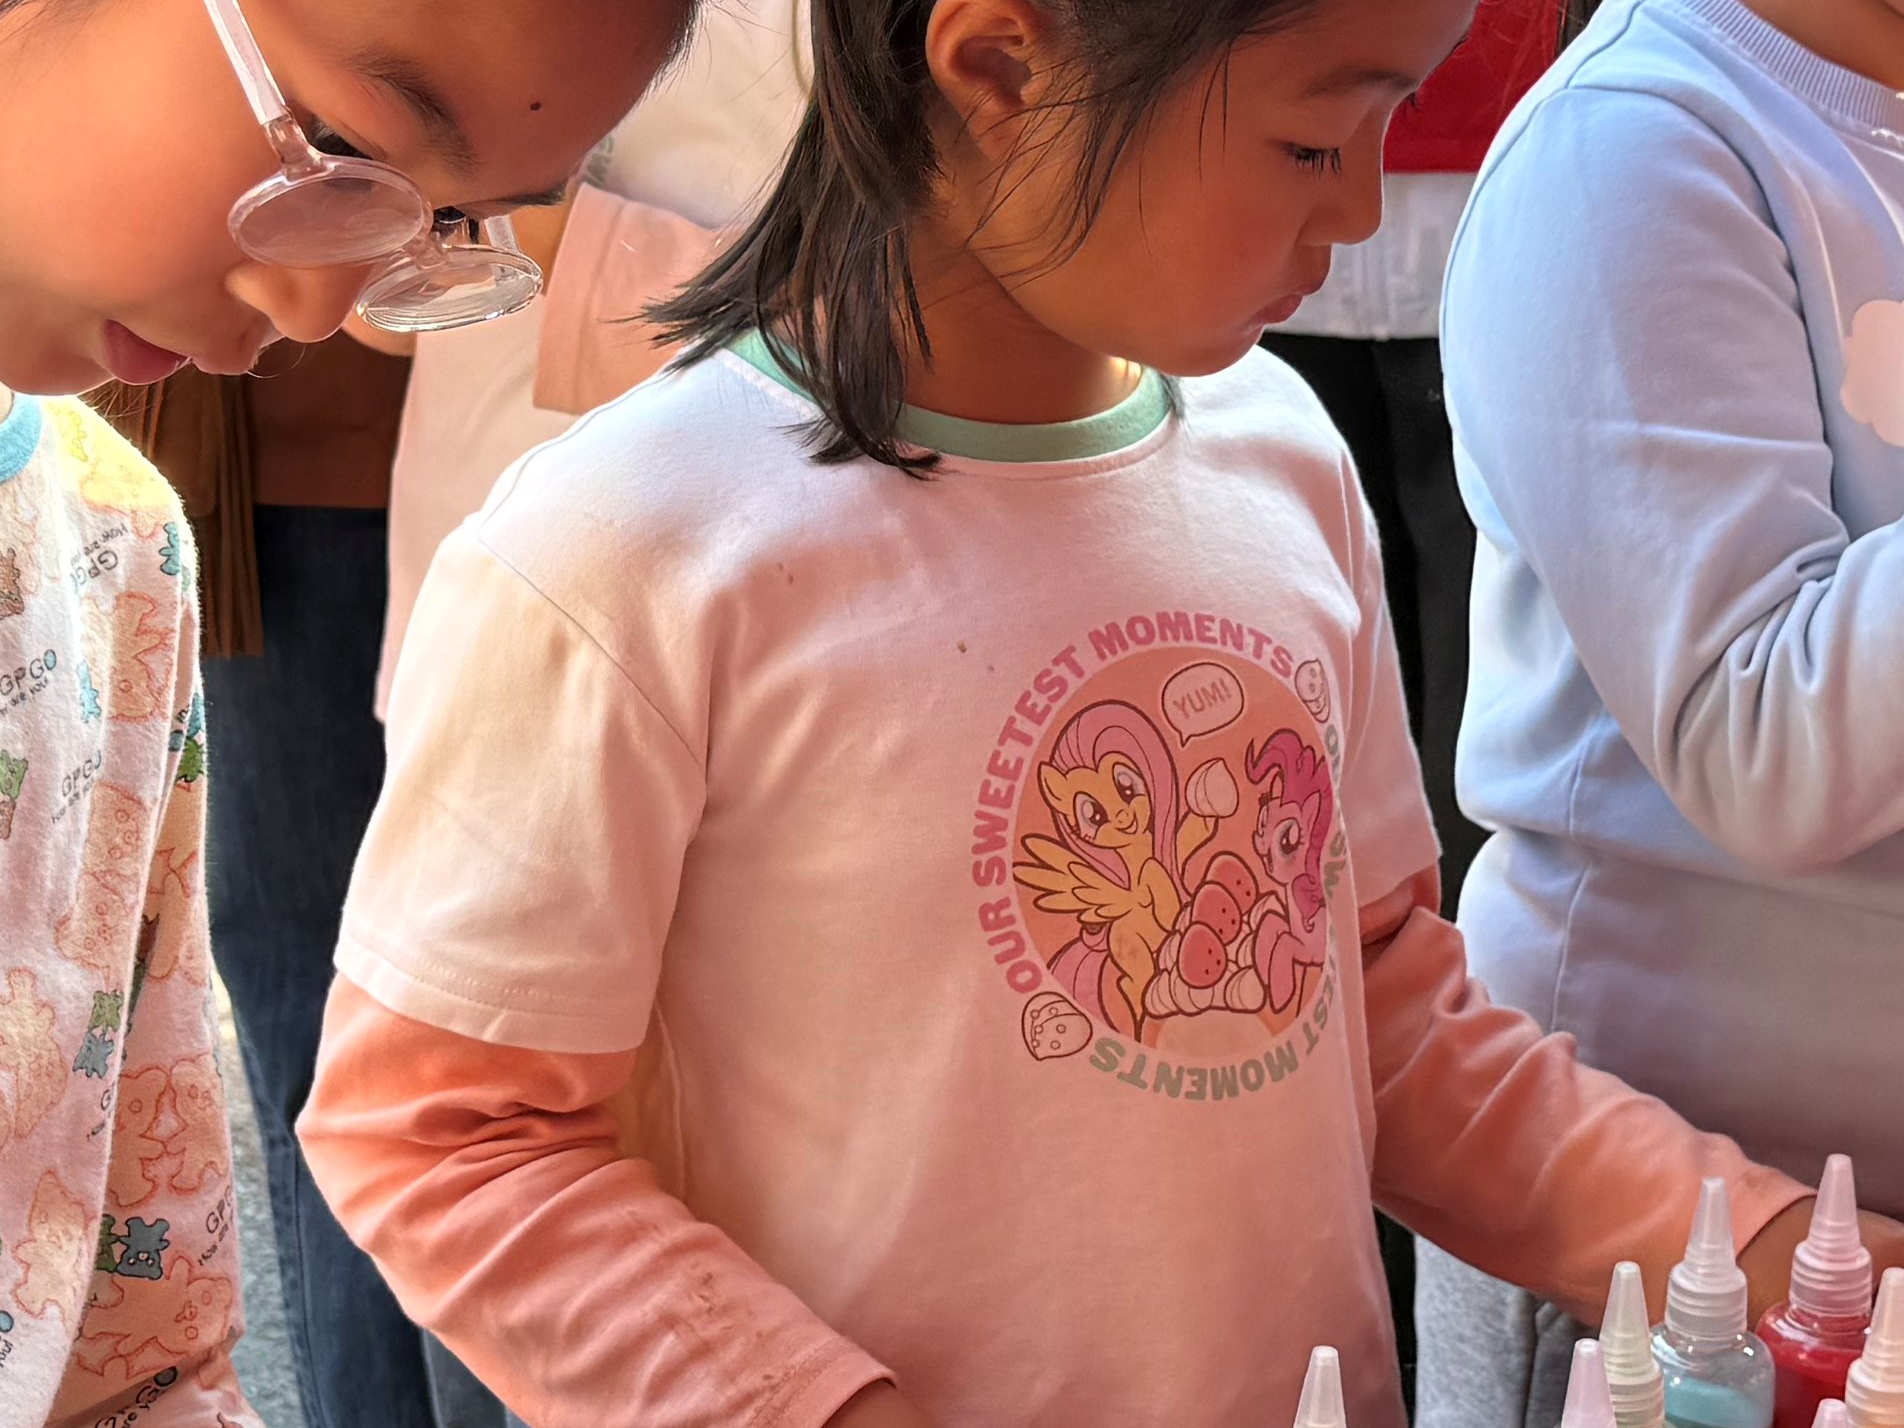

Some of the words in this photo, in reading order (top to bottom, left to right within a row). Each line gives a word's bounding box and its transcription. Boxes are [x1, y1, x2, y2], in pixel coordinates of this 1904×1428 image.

[1087, 610, 1297, 678] MOMENTS
[1172, 681, 1231, 720] YUM!
[971, 645, 1087, 890] SWEETEST
[978, 897, 1043, 994] OUR
[1089, 1036, 1301, 1101] MOMENTS
